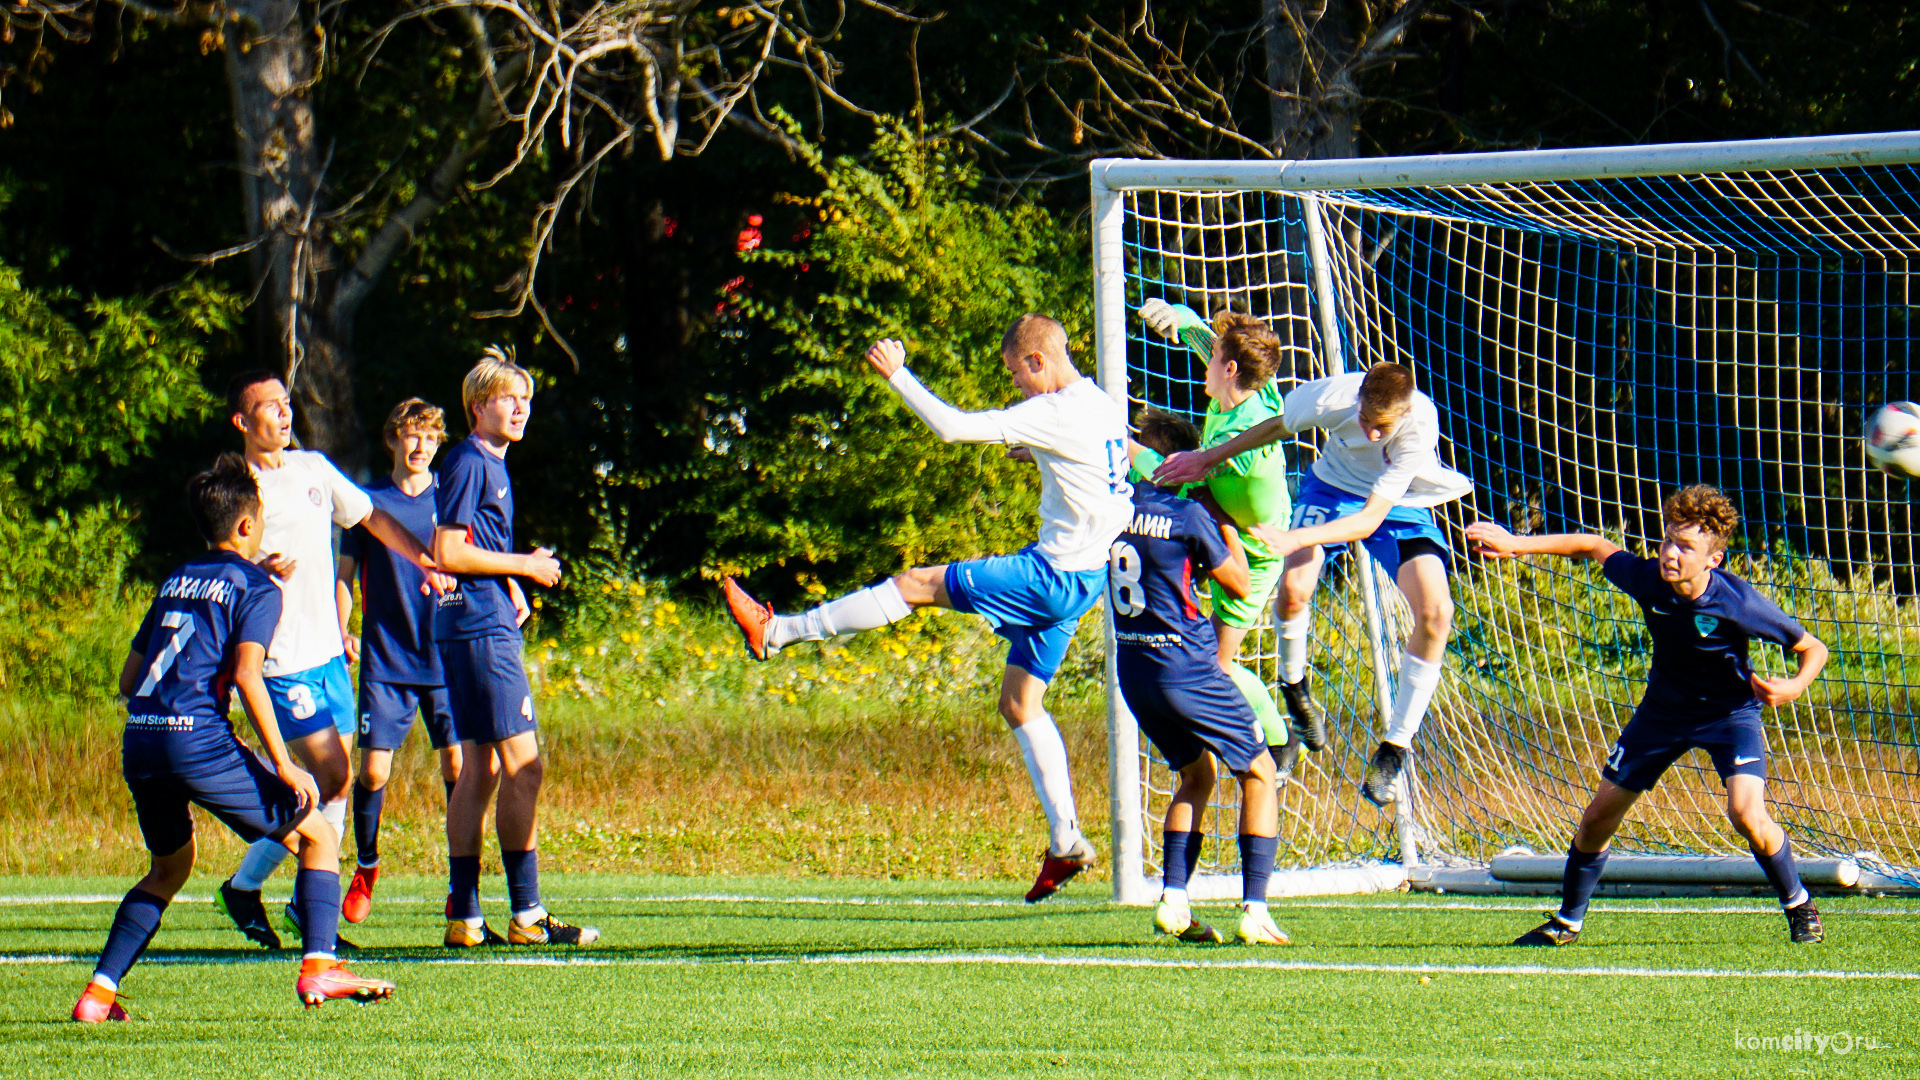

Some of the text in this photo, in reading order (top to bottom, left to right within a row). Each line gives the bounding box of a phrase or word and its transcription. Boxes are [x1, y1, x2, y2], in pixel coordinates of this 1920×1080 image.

[1290, 504, 1331, 529] 15
[1109, 541, 1146, 618] 8
[136, 611, 196, 697] 7
[286, 684, 317, 720] 3
[521, 695, 533, 721] 4
[361, 713, 371, 735] 5
